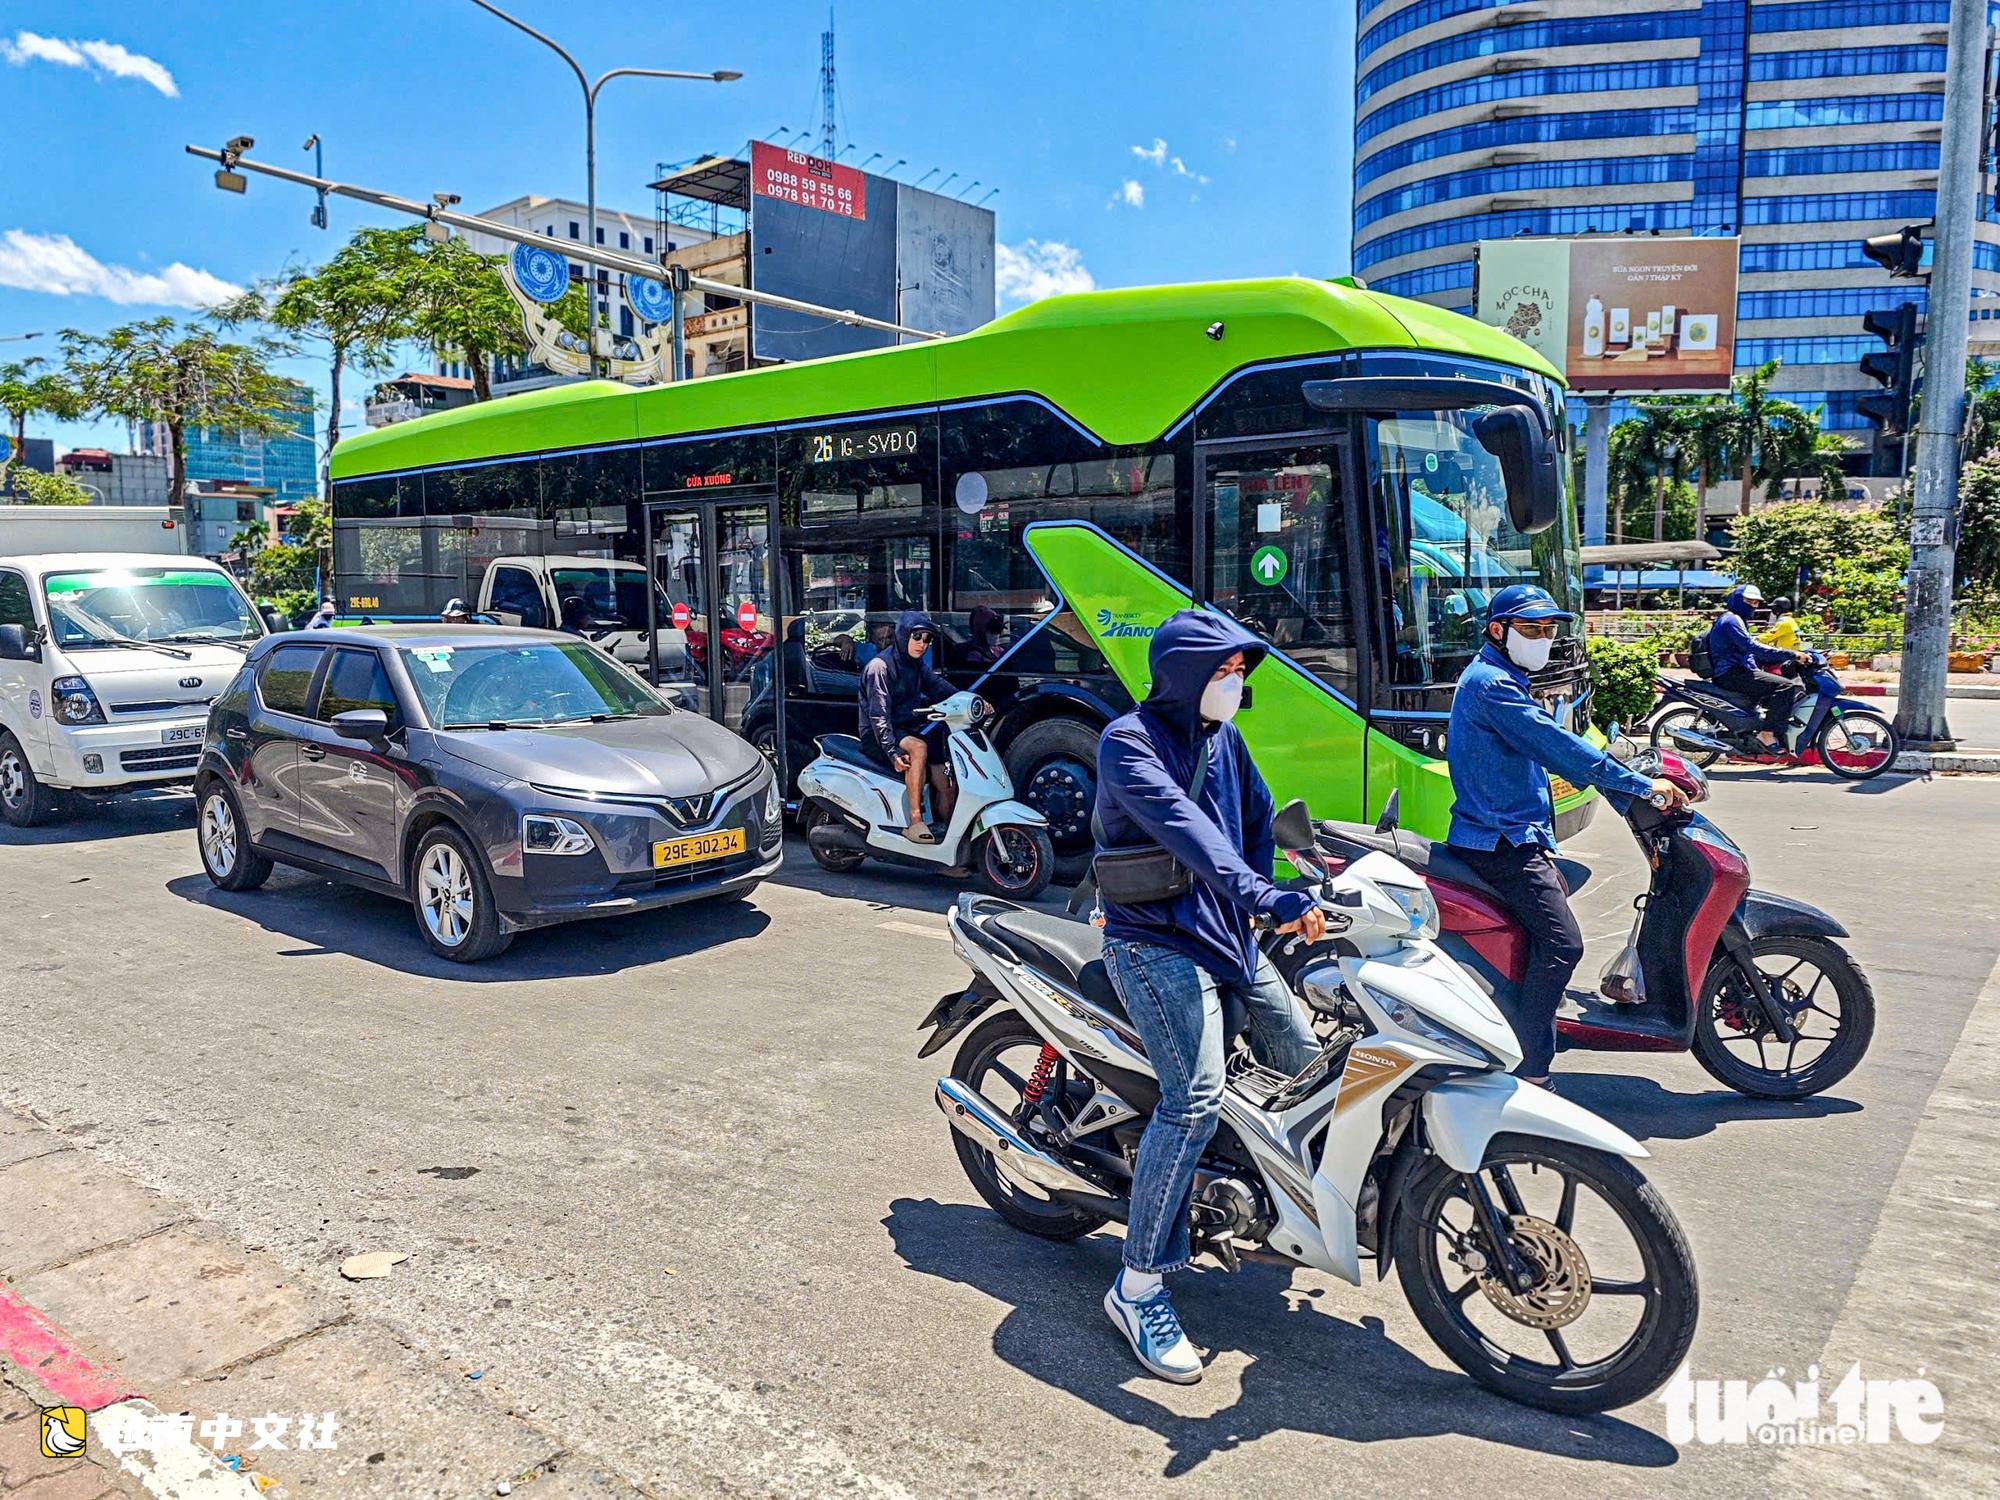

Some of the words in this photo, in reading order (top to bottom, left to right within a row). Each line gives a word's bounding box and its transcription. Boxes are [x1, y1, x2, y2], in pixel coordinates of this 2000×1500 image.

[767, 169, 798, 186] 0988
[801, 178, 816, 191] 59
[820, 182, 834, 196] 55
[838, 187, 852, 201] 66
[767, 183, 798, 201] 0978
[802, 192, 816, 205] 91
[820, 196, 834, 210] 70
[838, 201, 852, 215] 75
[814, 435, 833, 463] 26
[868, 432, 902, 454] SVĐ
[182, 678, 200, 687] KIA
[663, 835, 738, 861] 29E-302.34
[1355, 1050, 1397, 1068] HONDA
